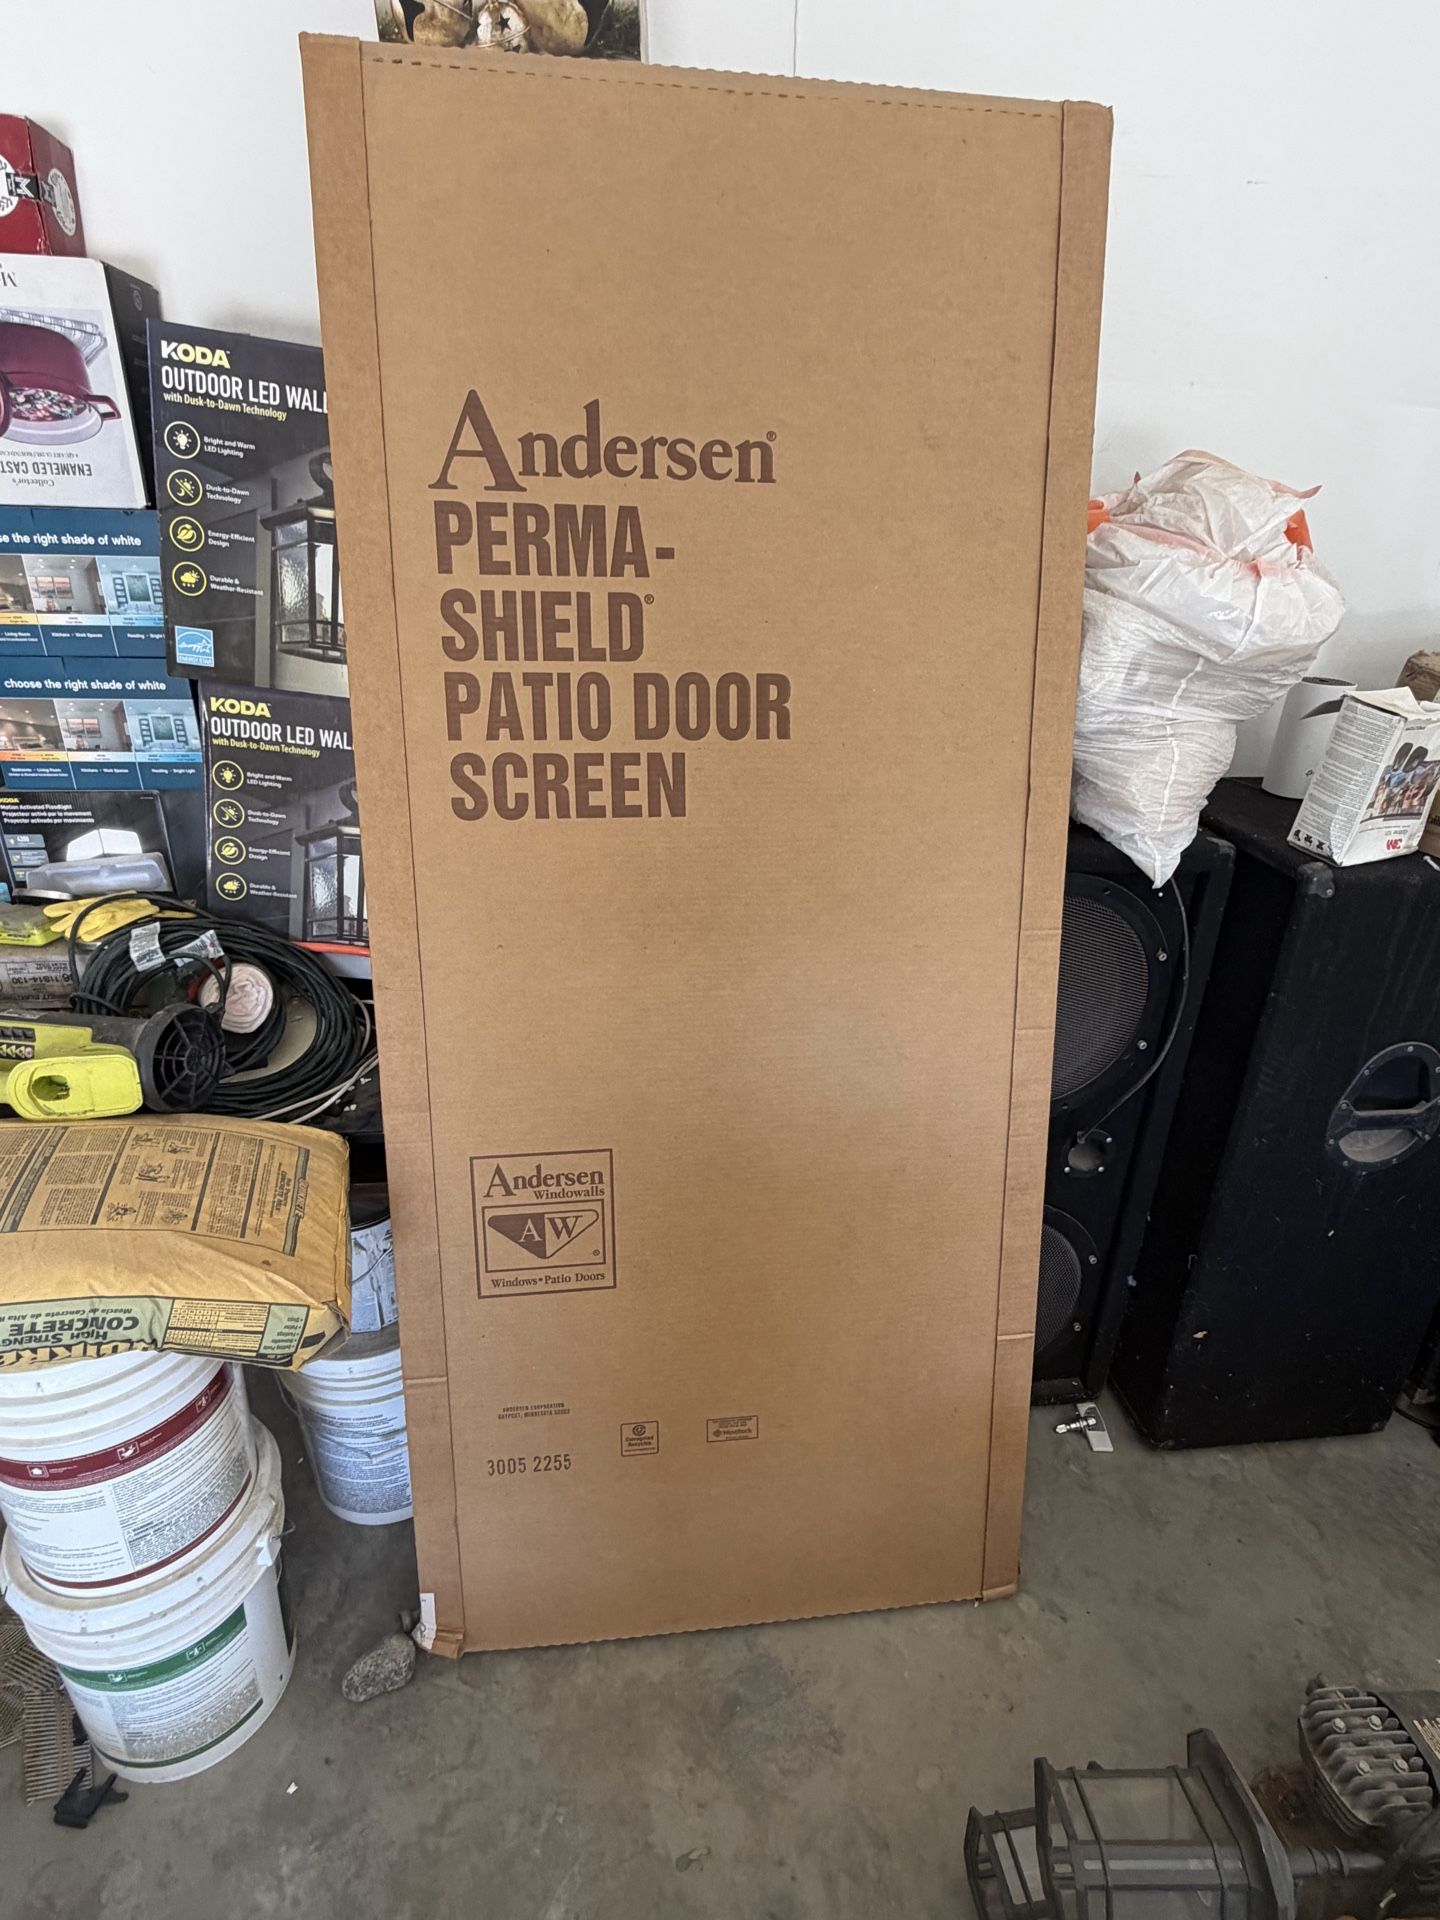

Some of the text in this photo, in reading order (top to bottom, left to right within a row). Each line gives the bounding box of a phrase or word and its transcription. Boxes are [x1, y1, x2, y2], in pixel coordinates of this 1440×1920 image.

[161, 340, 231, 369] KODA
[161, 365, 244, 400] OUTDOOR
[248, 379, 280, 405] LED
[163, 391, 287, 421] with Dusk-to-Dawn Technology
[203, 435, 256, 450] Bright and Warm
[204, 445, 244, 458] LED Lighting
[0, 461, 93, 477] ENAMELED CAST
[12, 478, 55, 487] Collector's
[206, 483, 250, 497] Dusk-to-Dawn
[206, 492, 242, 504] Technology
[12, 532, 30, 544] the
[33, 533, 59, 547] right
[61, 533, 95, 545] shade
[98, 534, 109, 545] of
[111, 534, 142, 546] white
[433, 500, 675, 578] PERMA-
[4, 678, 167, 692] choose the right shade of white
[210, 697, 271, 717] KODA
[444, 671, 792, 741] PATIO DOOR
[210, 716, 353, 750] OUTDOOR LED WAL
[212, 738, 320, 758] with Dusk-to-Dawn Technology
[450, 752, 687, 821] SCREEN
[483, 1163, 605, 1198] Andersen
[533, 1185, 605, 1200] Windowalls
[575, 1272, 606, 1282] Doors
[9, 1316, 140, 1336] CONCRETE
[70, 1330, 108, 1340] HIGH
[487, 1453, 572, 1476] 3005 2255
